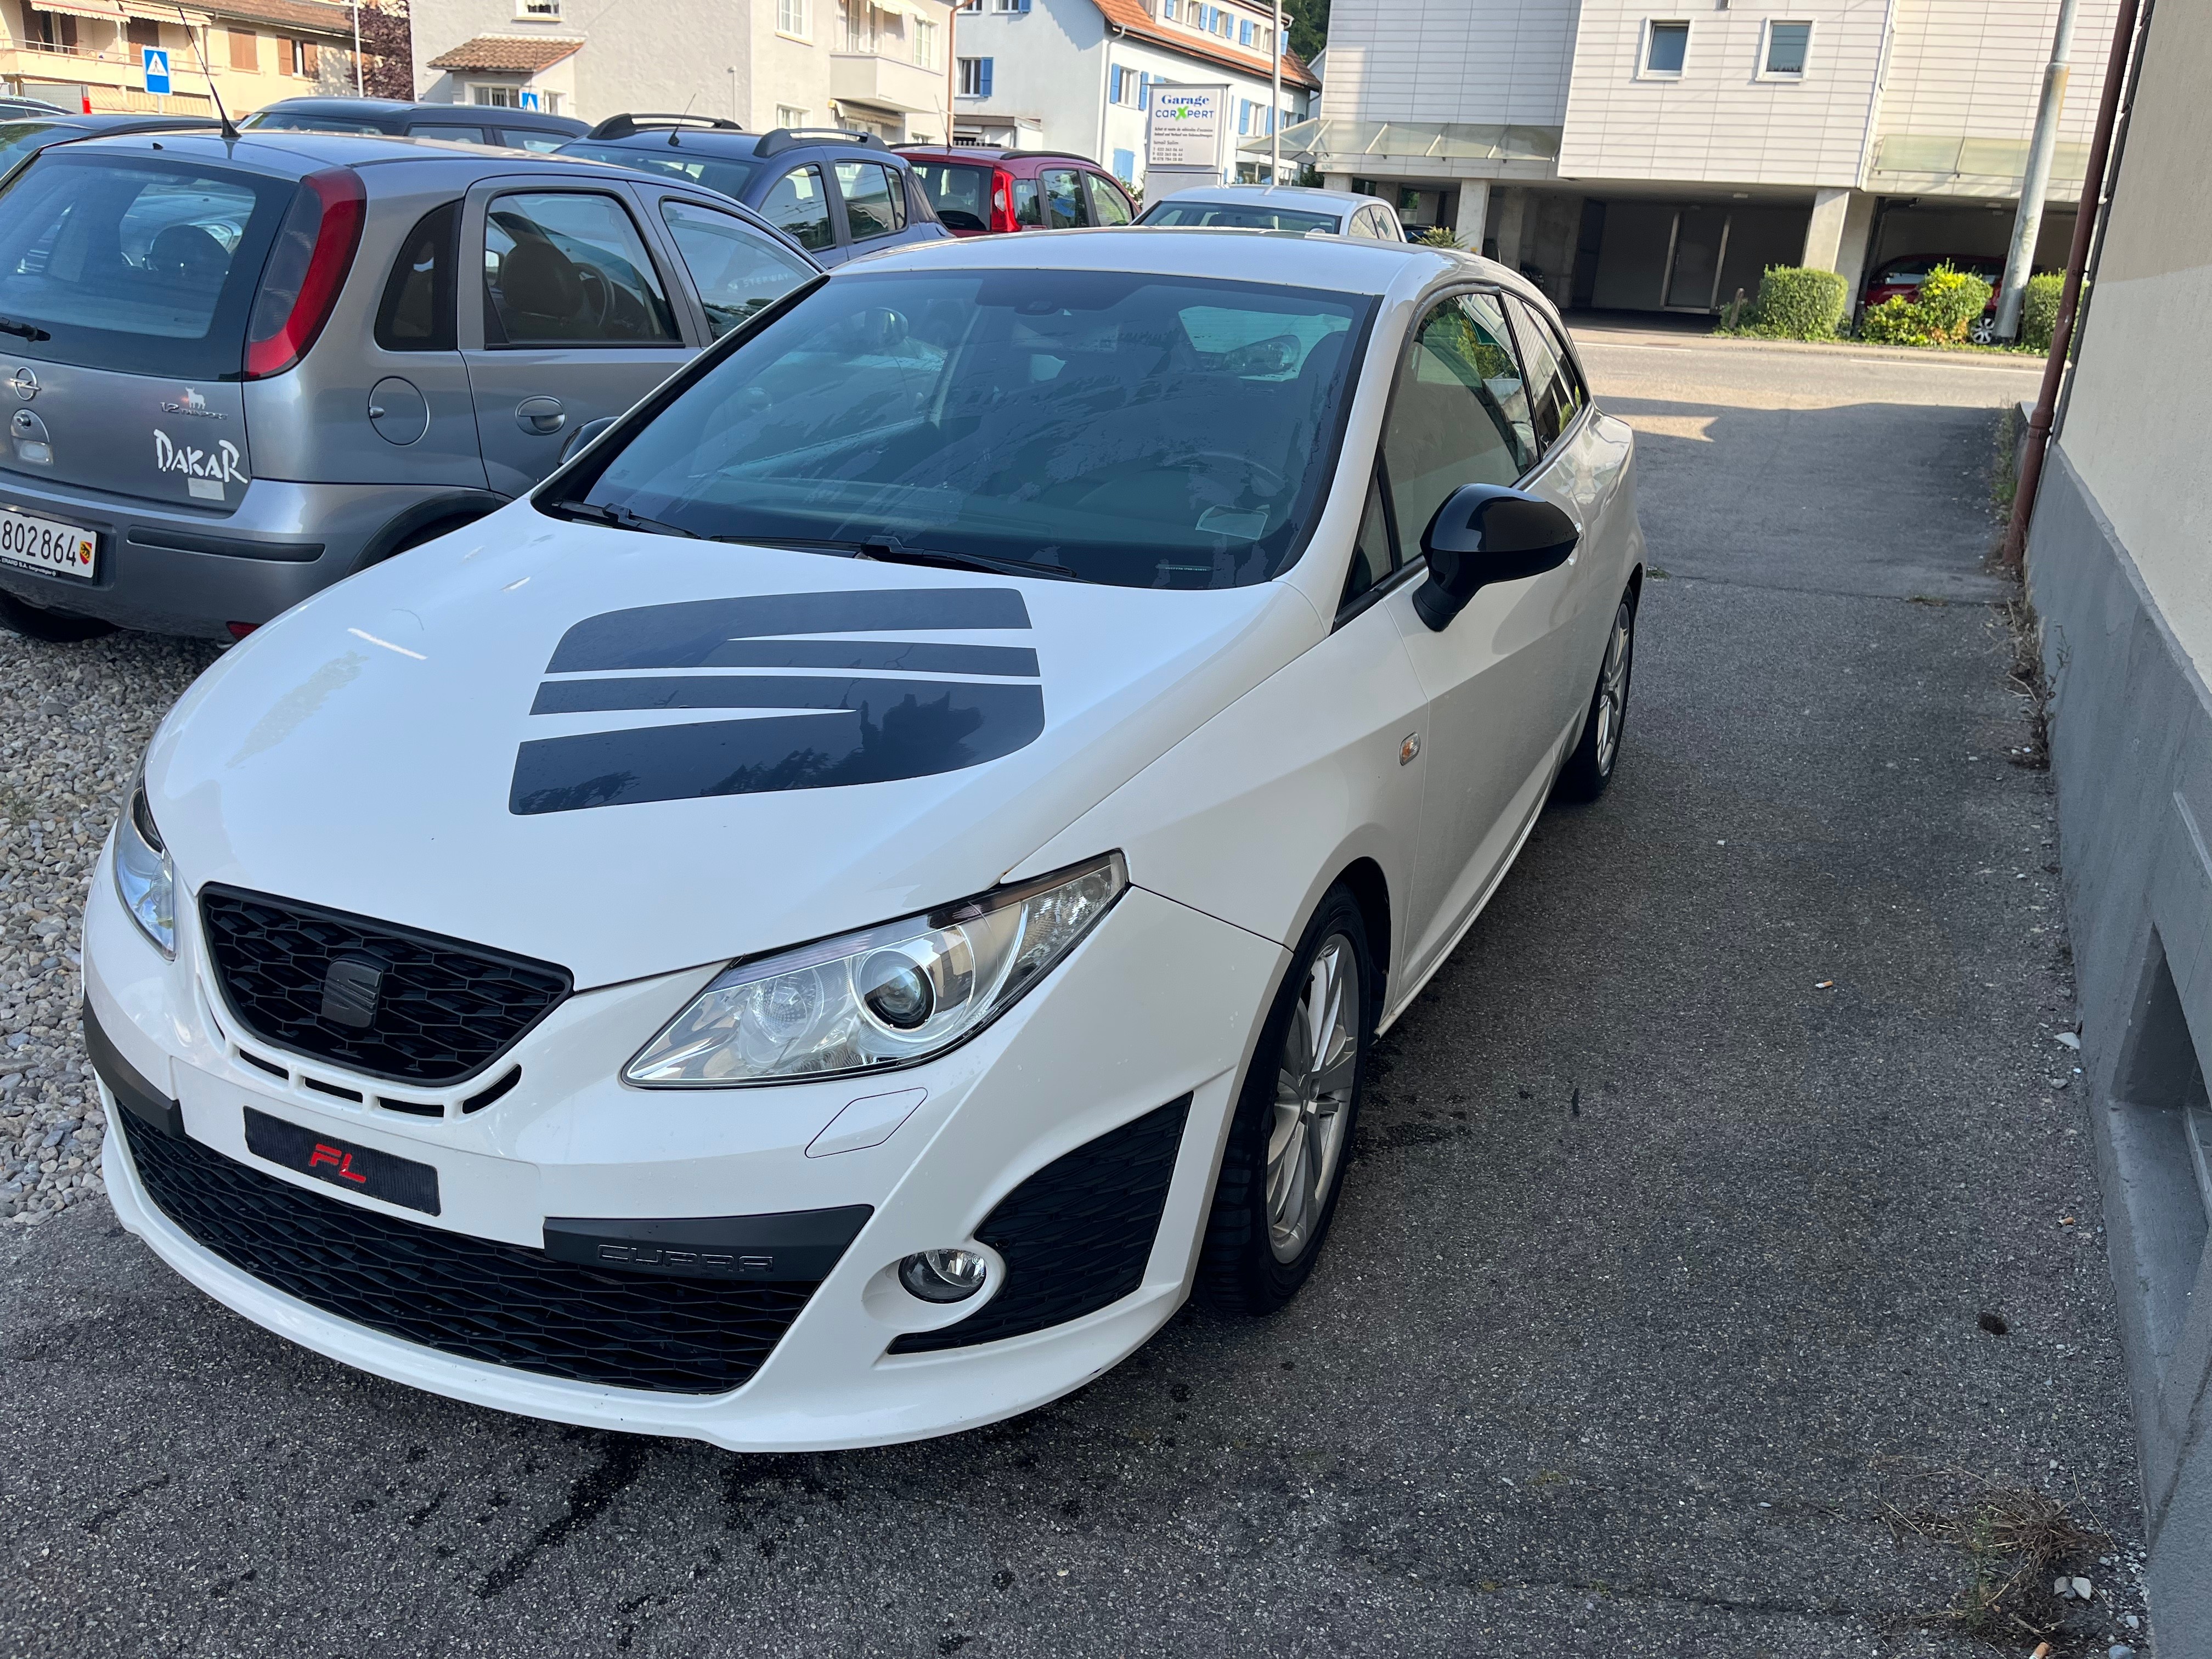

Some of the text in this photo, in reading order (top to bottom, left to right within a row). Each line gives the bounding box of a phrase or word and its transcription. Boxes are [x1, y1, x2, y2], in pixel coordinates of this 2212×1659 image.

[1161, 95, 1210, 107] Garage
[153, 428, 249, 484] DAKAR
[2, 520, 77, 567] 802864
[308, 1143, 367, 1184] FL
[597, 1244, 774, 1273] CUPRA
